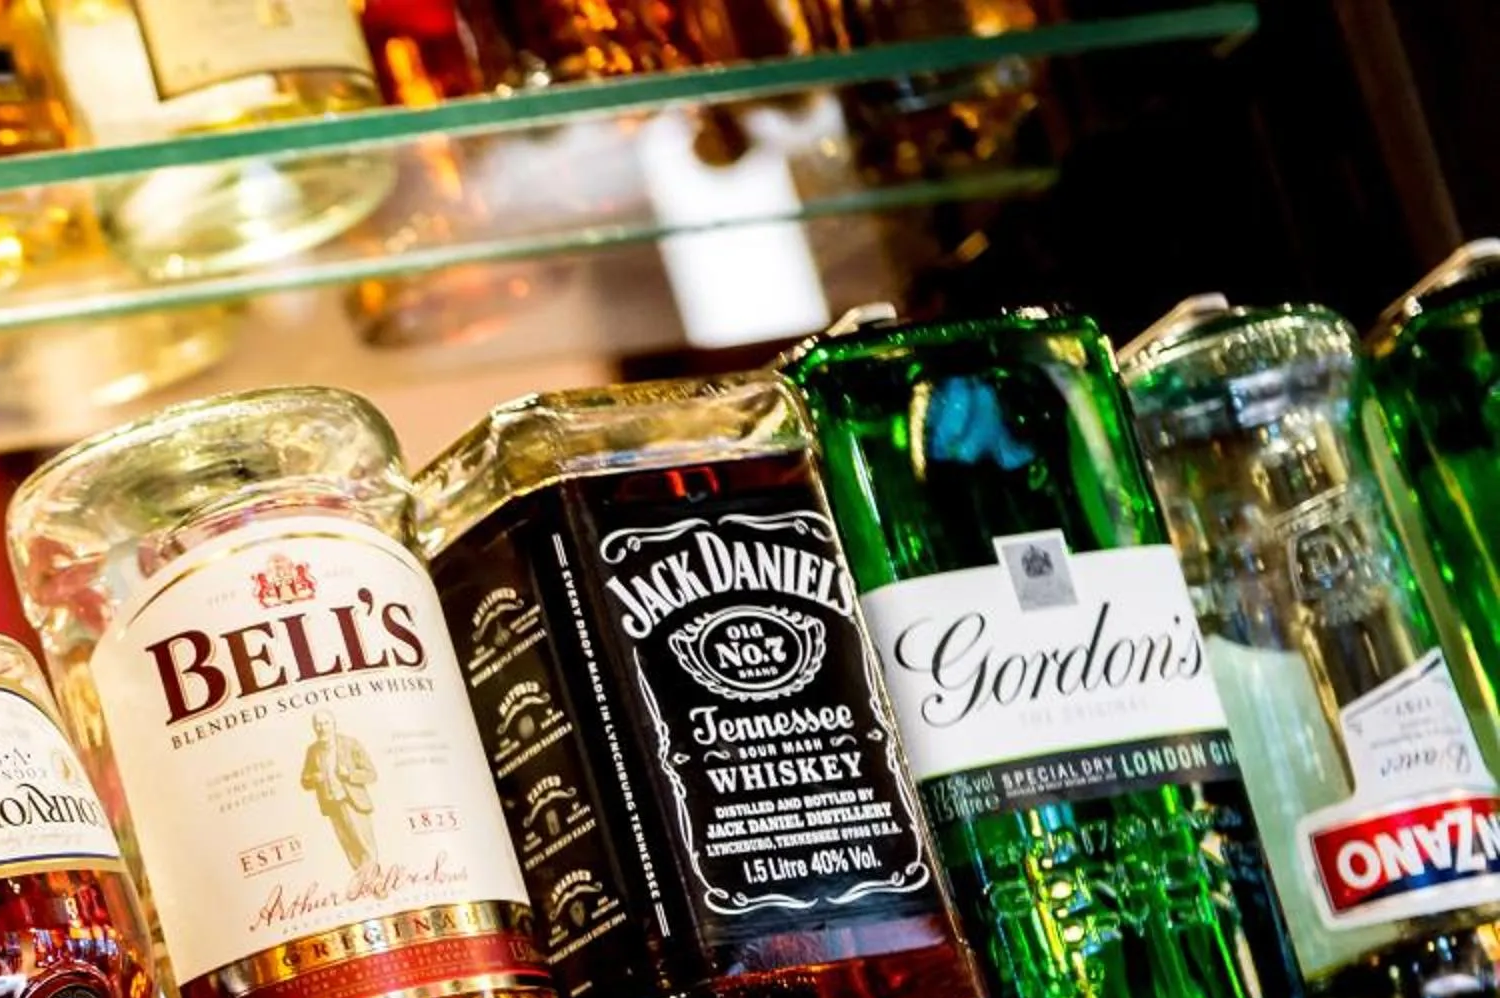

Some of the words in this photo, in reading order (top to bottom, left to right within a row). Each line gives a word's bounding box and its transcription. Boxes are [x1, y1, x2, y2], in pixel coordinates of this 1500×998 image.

[563, 570, 582, 617] EVERY
[606, 550, 710, 639] JACK
[575, 618, 594, 660] DROP
[726, 624, 764, 641] Old
[145, 587, 429, 726] BELL'S
[894, 602, 1202, 728] Gordon's
[587, 661, 606, 704] MADE
[171, 703, 268, 750] BLENDED
[277, 682, 363, 714] SCOTCH
[369, 676, 436, 694] WHISKY
[599, 703, 611, 721] IN
[689, 704, 855, 745] Tennessee
[602, 722, 637, 813] LYNCHBURG
[739, 744, 777, 760] SOUR
[782, 738, 823, 755] MASH
[1001, 761, 1077, 788] SPECIAL
[1080, 757, 1116, 779] DRY
[1119, 741, 1206, 778] LONDON
[706, 751, 863, 794] WHISKEY
[707, 818, 747, 839] JACK
[747, 811, 805, 835] DANIEL
[806, 801, 893, 828] DISTILLERY
[715, 800, 776, 819] DISTILLED
[777, 796, 801, 812] AND
[803, 789, 856, 809] BOTTLED
[857, 787, 875, 802] BY
[630, 813, 661, 900] TENNESSEE
[769, 854, 809, 882] Litre
[810, 848, 849, 877] 40%
[848, 843, 883, 870] Vol.
